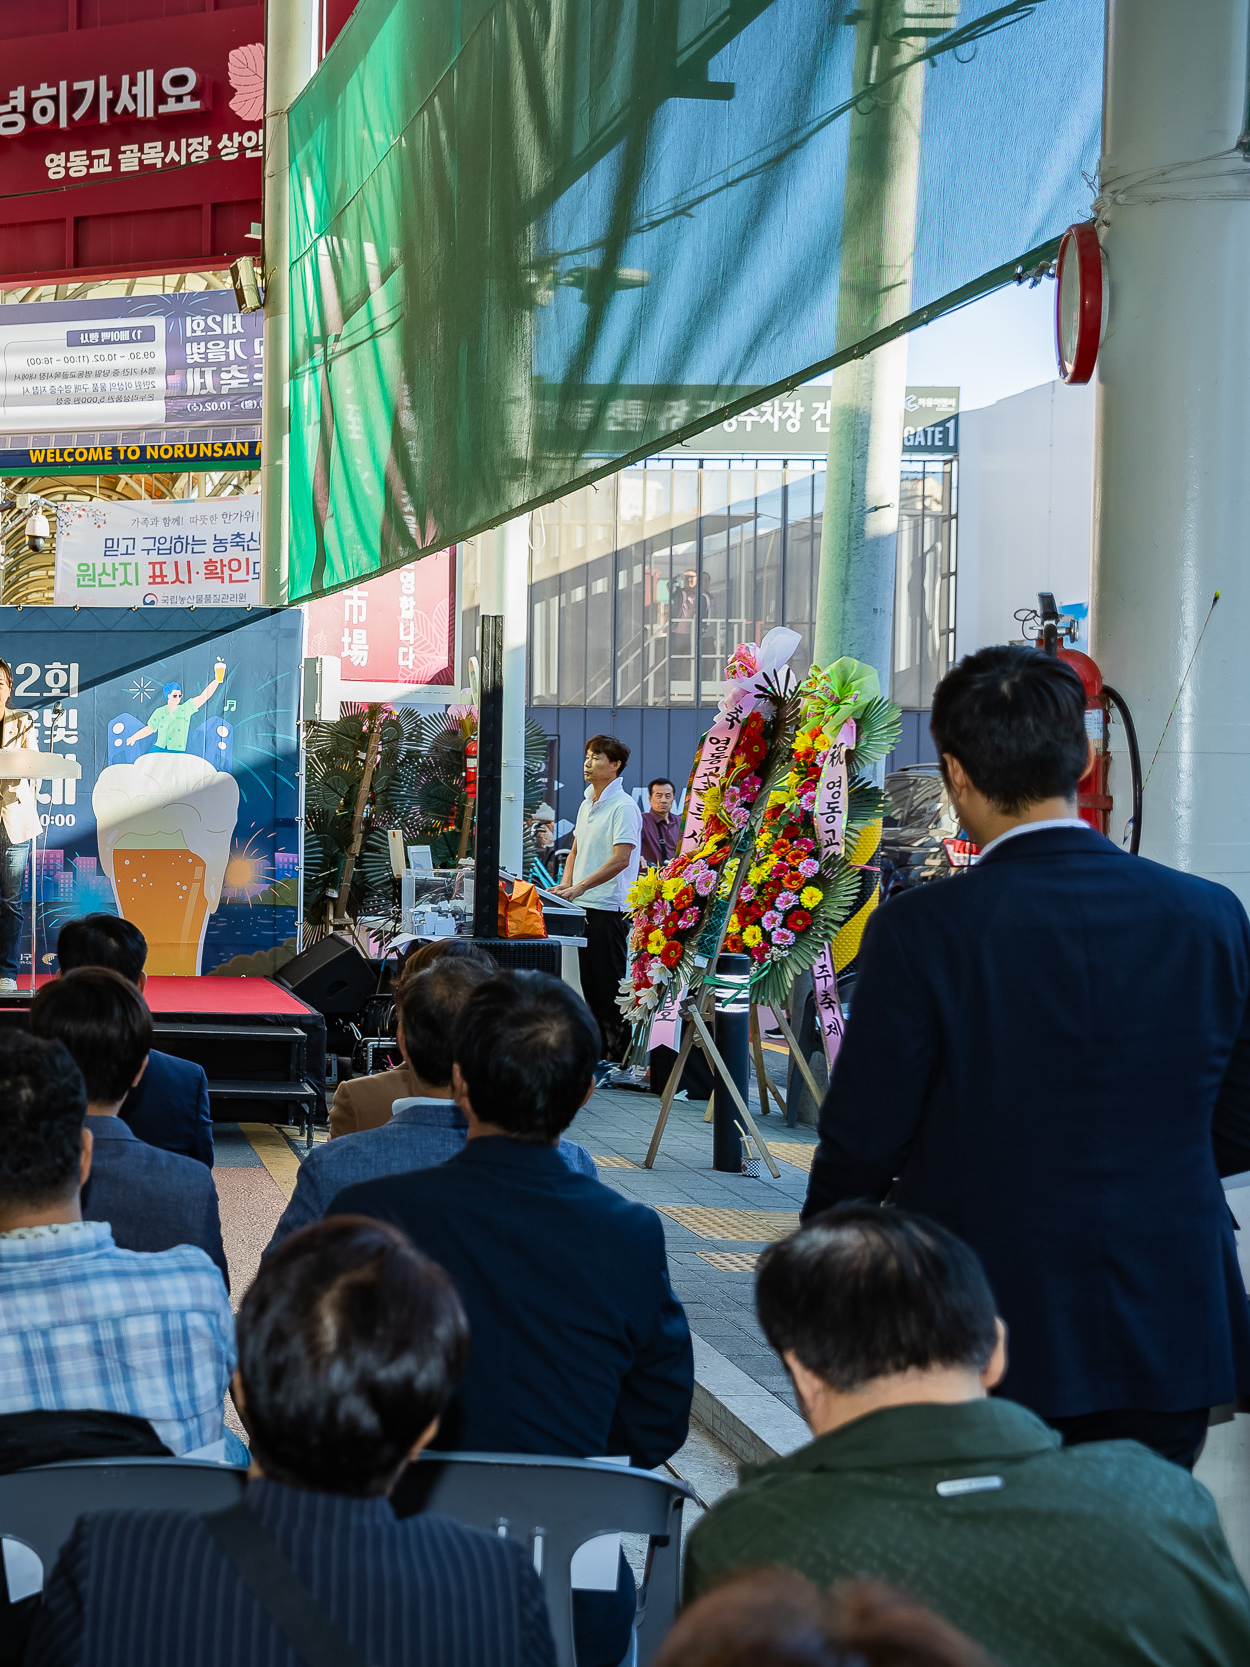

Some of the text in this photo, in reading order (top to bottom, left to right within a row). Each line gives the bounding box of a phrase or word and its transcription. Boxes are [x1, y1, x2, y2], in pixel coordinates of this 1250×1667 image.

[44, 129, 264, 179] 영동교 골목시장 상인
[903, 419, 956, 447] GATE 1
[29, 447, 112, 464] WELCOME
[118, 446, 141, 461] TO
[146, 442, 249, 460] NORUNSAN
[131, 510, 260, 529] 가족과 함께! 따뜻한 한가위!
[103, 536, 136, 557] 믿고
[141, 534, 207, 555] 구입하는
[76, 562, 139, 588] 원산지
[161, 592, 247, 605] 국립농산물품질관리원
[725, 704, 744, 730] 축
[828, 742, 845, 768] 祝
[819, 775, 843, 848] 영동교
[814, 951, 843, 1038] 주축제
